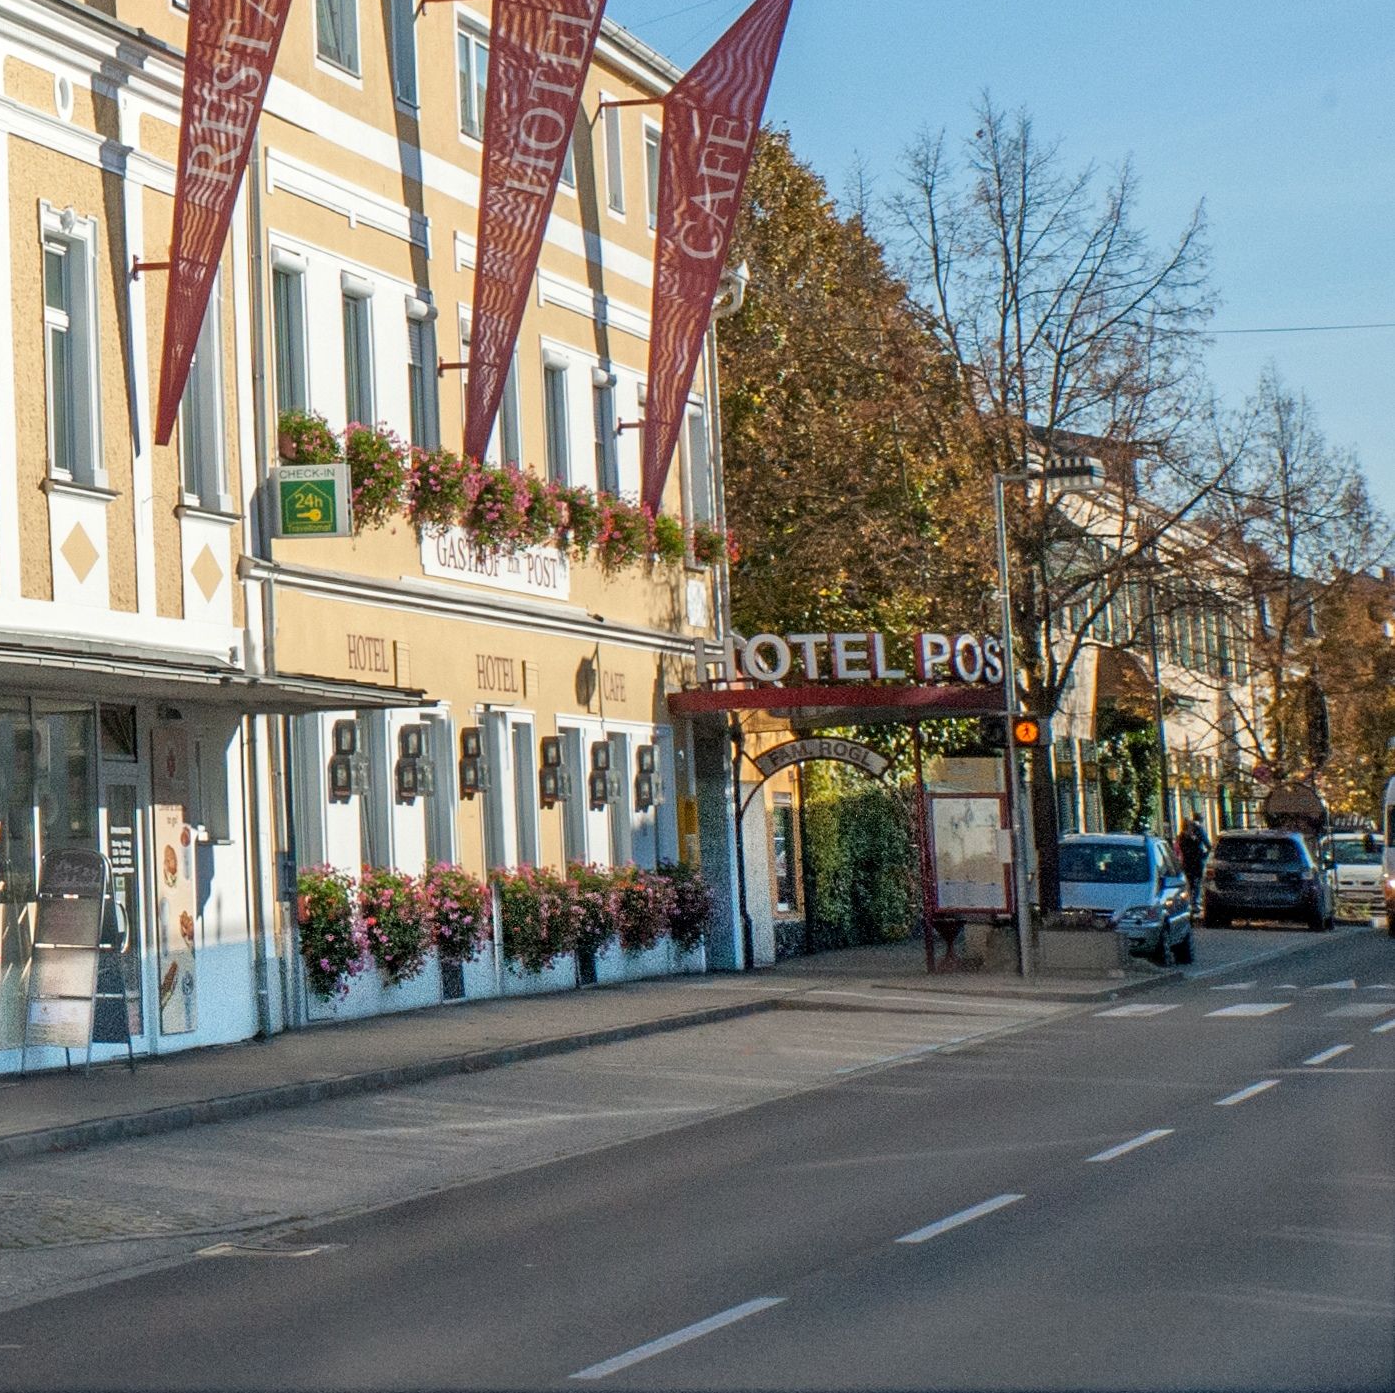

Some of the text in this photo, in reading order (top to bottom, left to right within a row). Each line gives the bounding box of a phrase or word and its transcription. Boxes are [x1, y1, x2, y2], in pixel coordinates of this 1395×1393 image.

[678, 112, 754, 261] CAFE
[279, 468, 336, 480] CHECK-IN
[295, 493, 324, 509] 24h
[525, 552, 558, 589] POST
[346, 633, 390, 673] HOTEL
[693, 632, 1006, 684] HOTEL POS
[475, 653, 519, 694] HOTEL
[819, 740, 872, 768] ROGL
